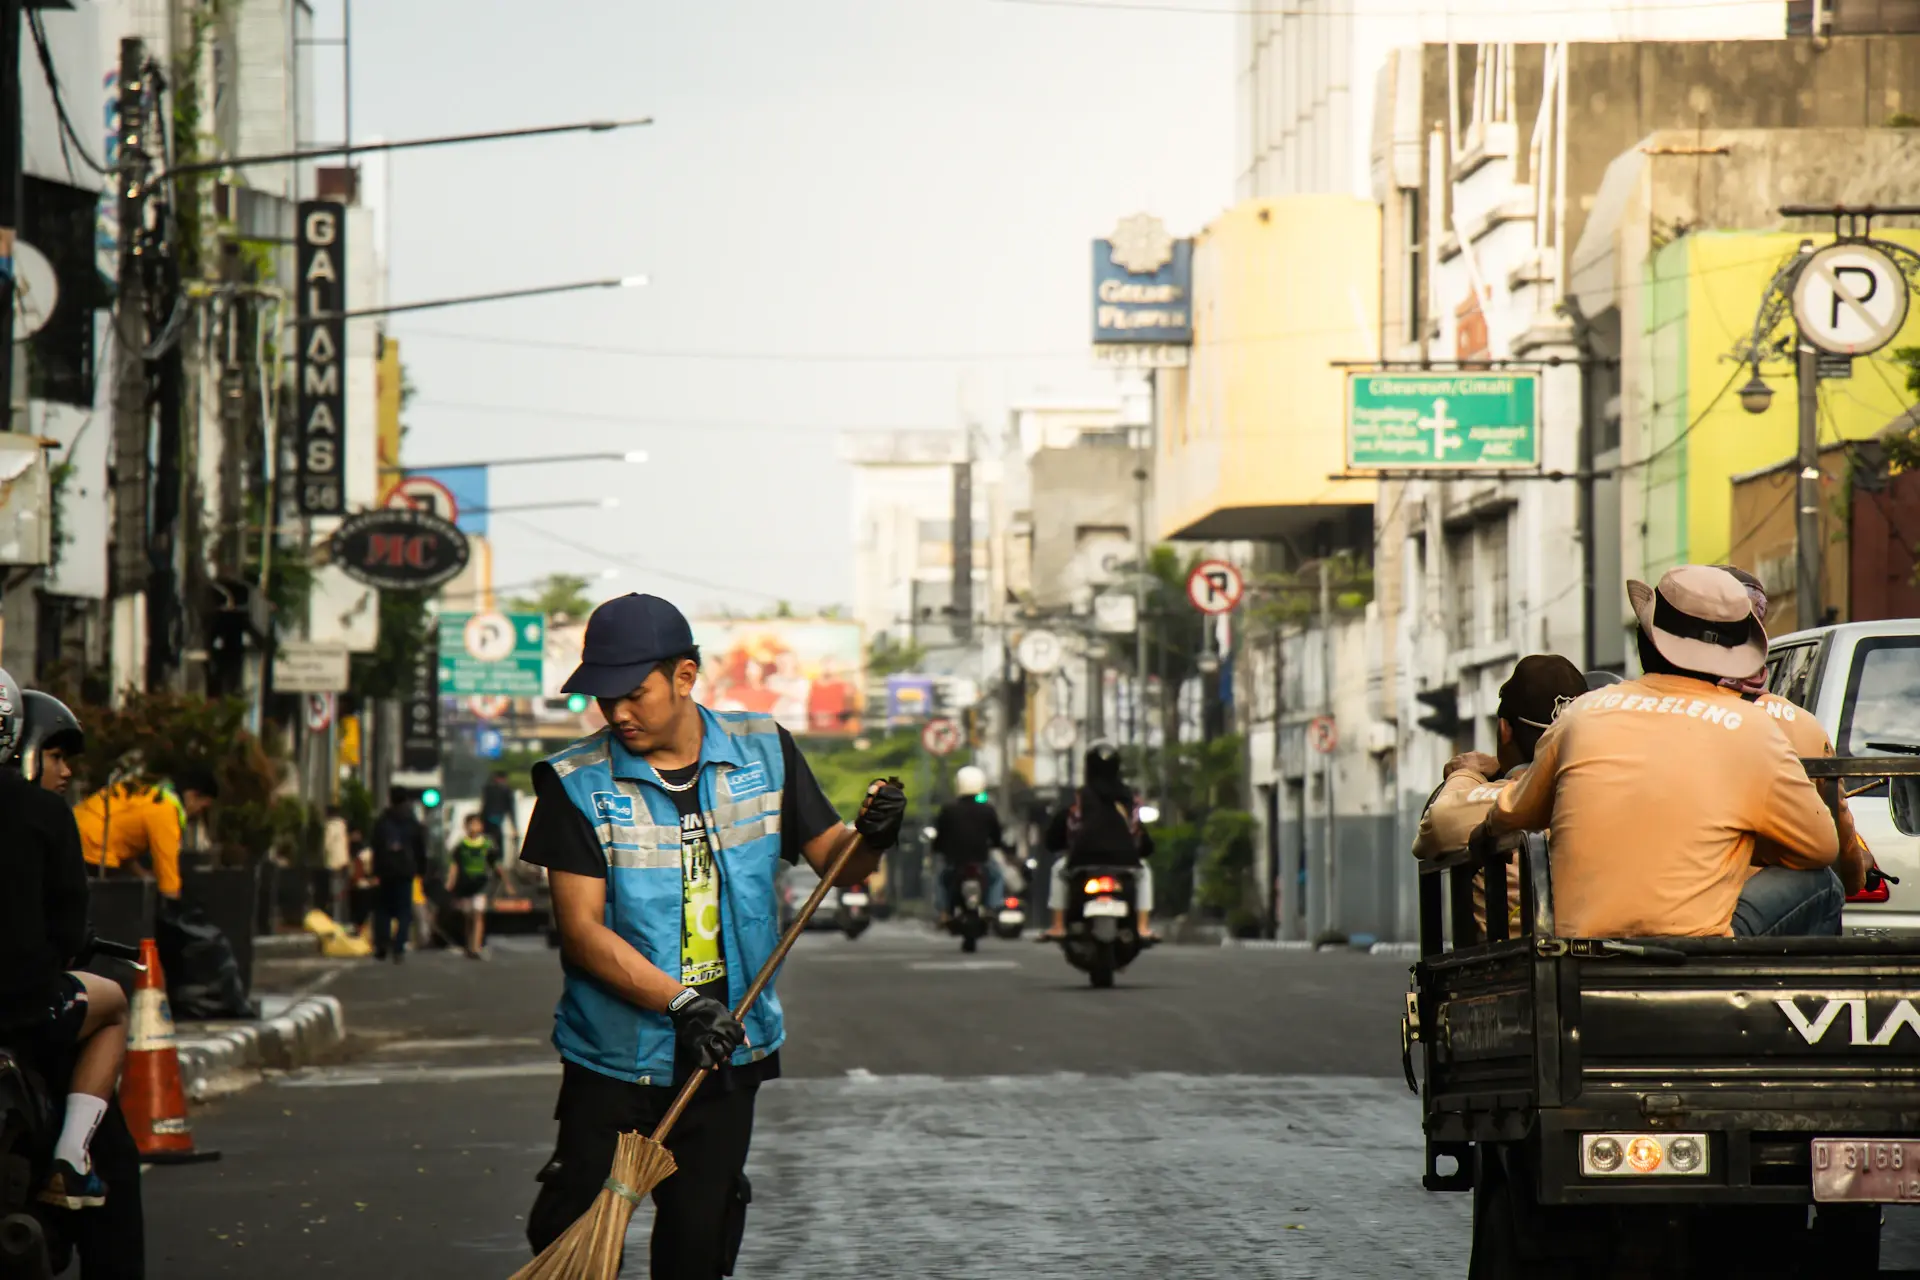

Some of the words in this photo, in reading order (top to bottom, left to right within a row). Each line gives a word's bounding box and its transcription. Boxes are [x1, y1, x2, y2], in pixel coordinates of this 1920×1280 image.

[1831, 266, 1877, 329] P
[305, 211, 339, 473] GALAMAS
[364, 532, 438, 569] MC
[1753, 700, 1796, 722] NG
[1815, 1143, 1829, 1169] D
[1844, 1142, 1904, 1169] 3168
